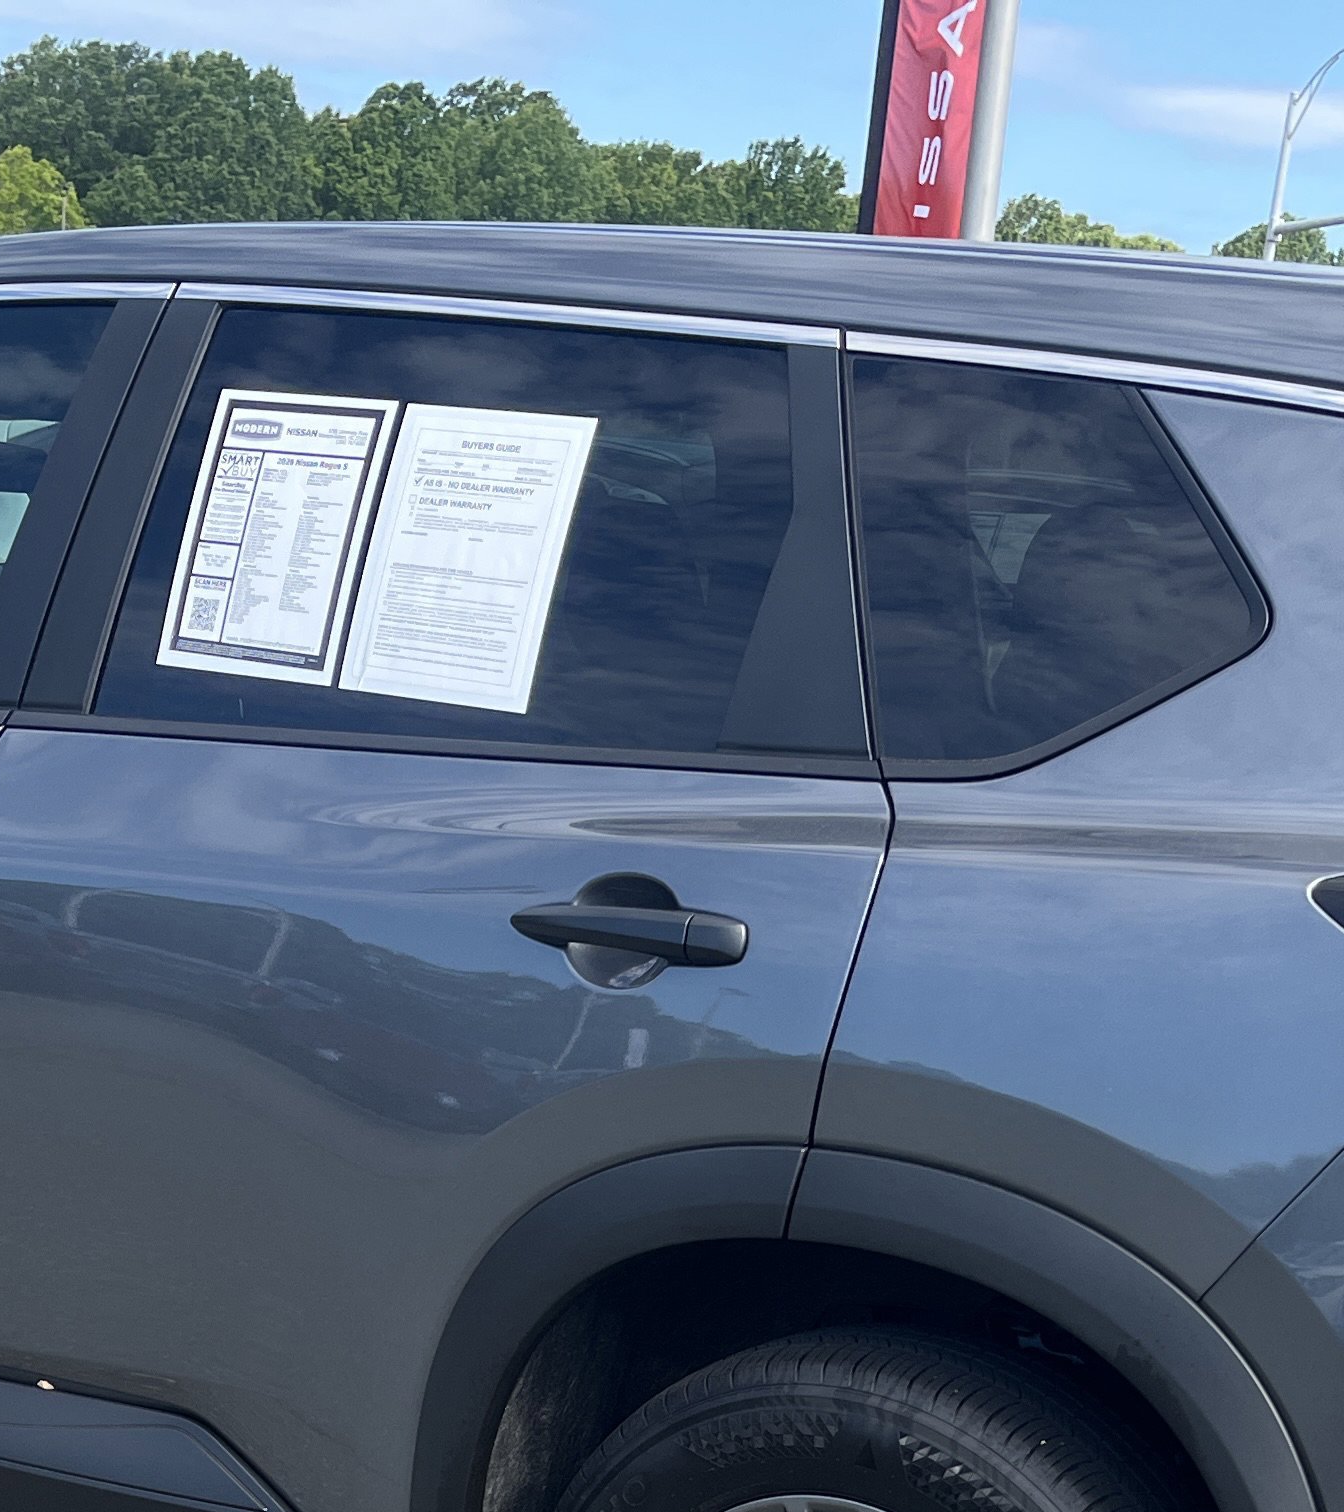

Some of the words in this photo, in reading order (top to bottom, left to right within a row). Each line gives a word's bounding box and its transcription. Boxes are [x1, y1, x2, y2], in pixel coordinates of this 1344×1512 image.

[234, 423, 279, 435] MODERN
[286, 427, 319, 438] NISSAN
[461, 440, 494, 451] BUYERS
[495, 443, 521, 454] GUIDE
[220, 453, 261, 466] SMART
[231, 465, 257, 477] BUY
[423, 479, 434, 487] AS
[448, 480, 459, 489] NO
[460, 482, 490, 492] DEALER
[492, 484, 535, 496] WARRANTY
[418, 496, 448, 507] DEALER
[450, 499, 492, 511] WARRANTY
